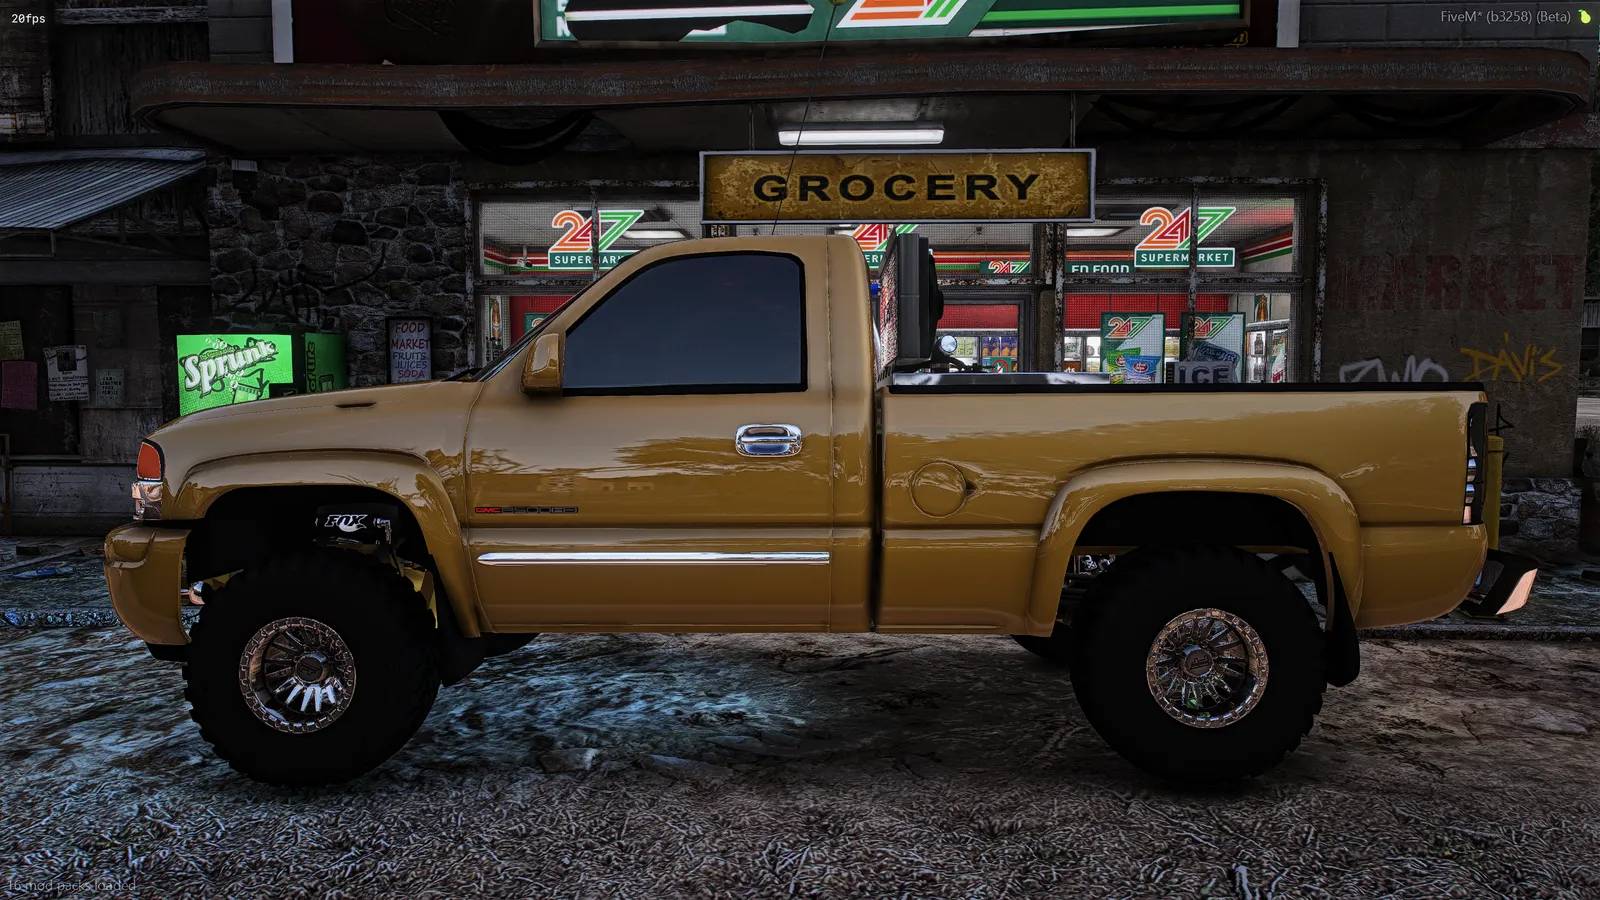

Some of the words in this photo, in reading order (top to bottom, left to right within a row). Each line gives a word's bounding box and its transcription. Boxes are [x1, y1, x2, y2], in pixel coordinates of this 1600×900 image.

[754, 173, 1041, 202] GROCERY
[1141, 253, 1229, 262] SUPERMRKET
[396, 322, 425, 333] FOOD
[391, 338, 430, 350] MARKET
[392, 352, 426, 360] FRUITS
[184, 341, 277, 395] Sprunk
[395, 360, 427, 369] JUICES
[398, 369, 425, 378] SODA
[1178, 365, 1230, 383] ICE
[324, 514, 368, 532] FOX
